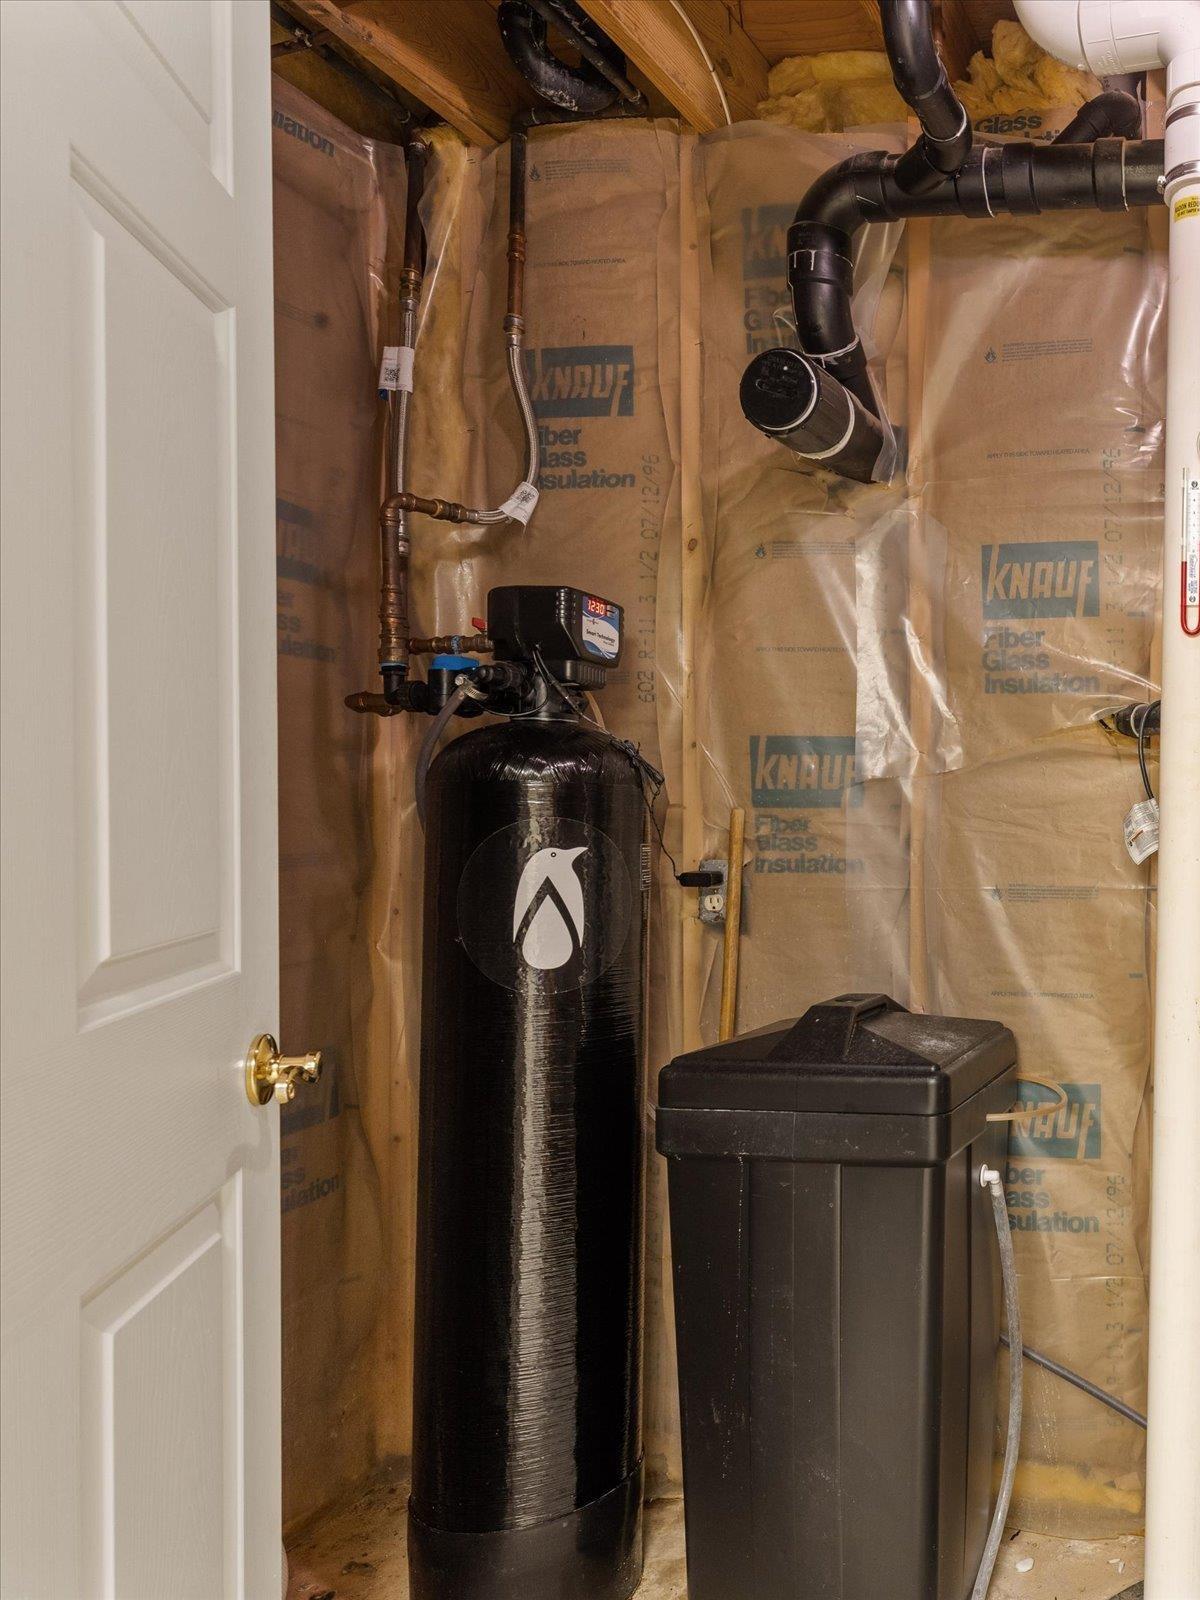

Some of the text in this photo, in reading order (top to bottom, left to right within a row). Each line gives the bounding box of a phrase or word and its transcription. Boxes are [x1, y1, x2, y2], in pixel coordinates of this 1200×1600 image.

[975, 115, 1041, 133] Glass
[532, 346, 631, 417] KNAUF
[537, 424, 582, 446] iber
[539, 449, 587, 468] lass
[537, 469, 635, 490] nsulation
[985, 543, 1096, 618] KNAUF
[984, 626, 1046, 649] Fiber
[982, 650, 1050, 672] Glass
[984, 673, 1099, 694] Insulation
[1006, 1162, 1046, 1185] ber
[1006, 1190, 1050, 1209] ass
[1008, 1211, 1100, 1234] sulation
